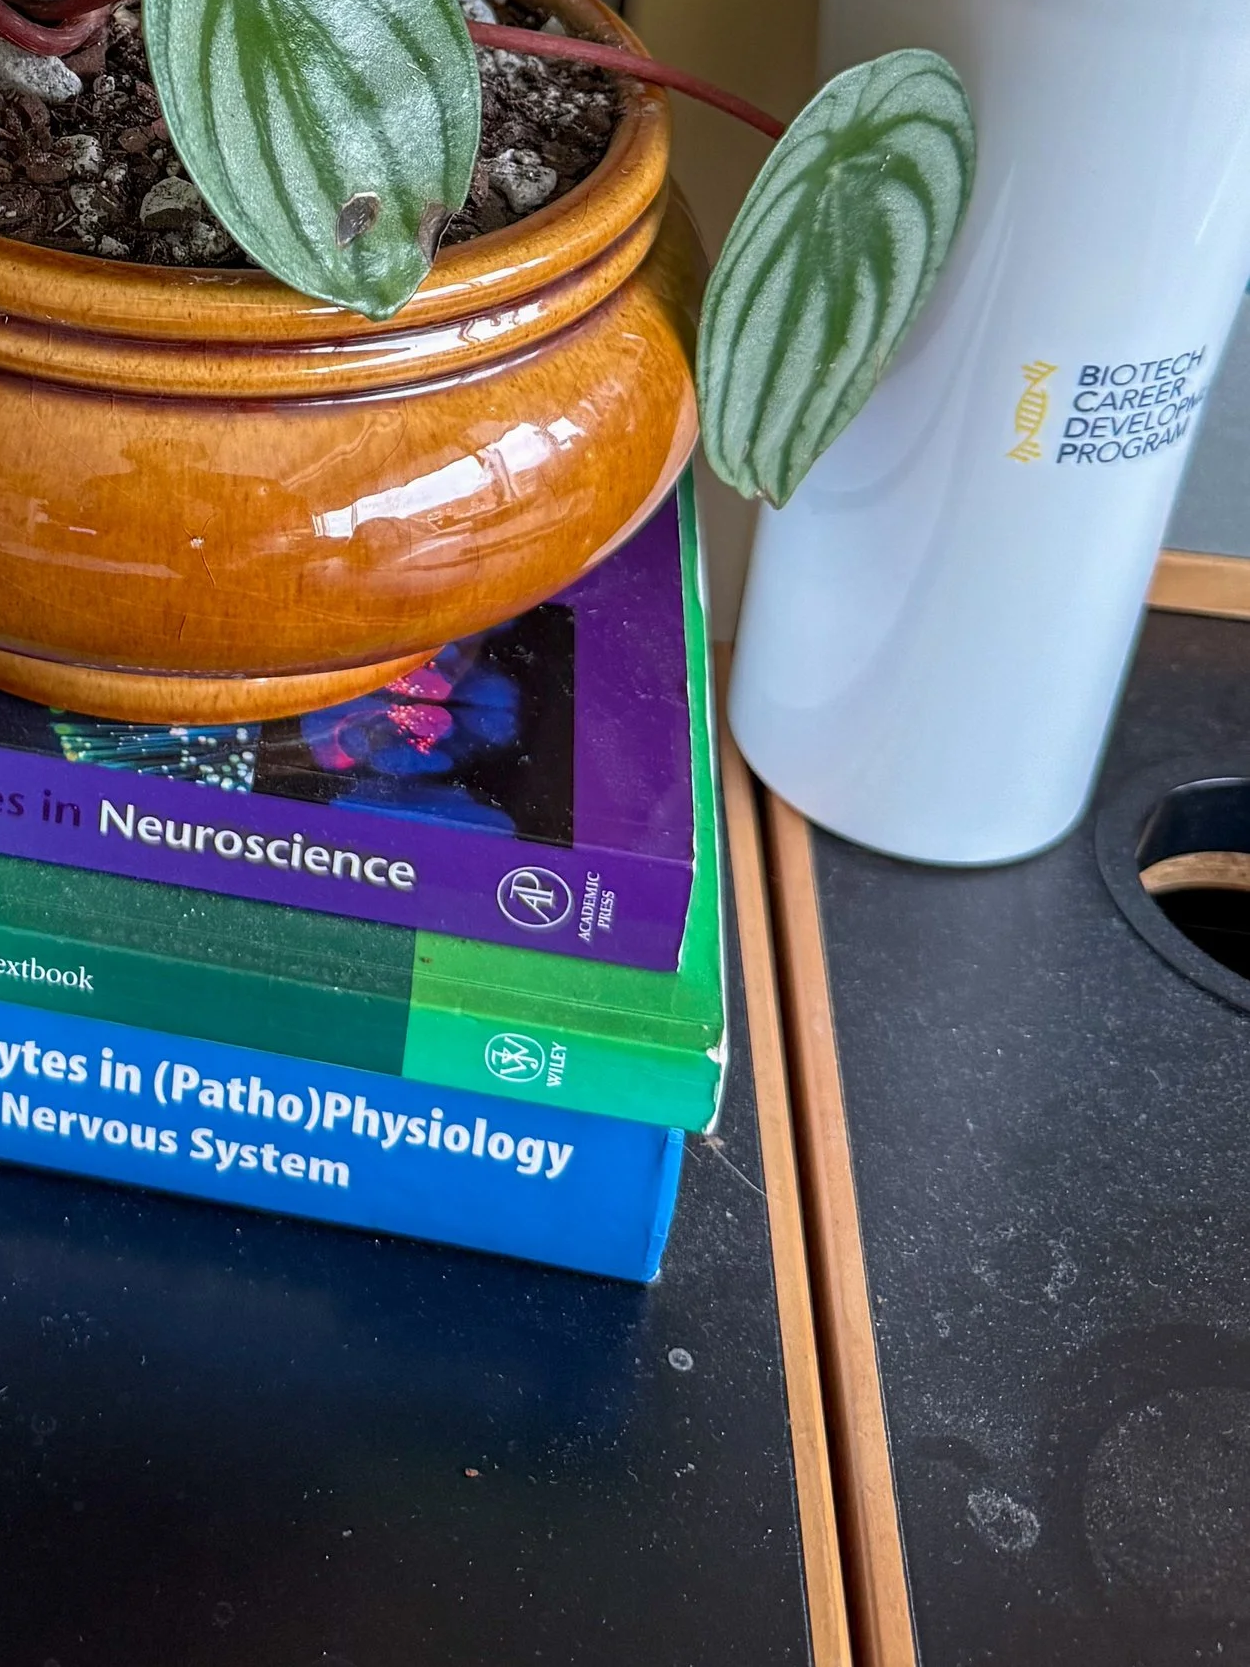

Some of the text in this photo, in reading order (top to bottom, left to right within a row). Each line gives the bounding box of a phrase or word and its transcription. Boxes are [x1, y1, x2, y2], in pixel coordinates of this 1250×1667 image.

[1078, 344, 1206, 386] BIOTECH
[1073, 377, 1186, 413] CAREER
[1056, 416, 1190, 464] PROGRAM
[42, 789, 81, 827] in
[100, 798, 417, 890] Neuroscience
[578, 871, 600, 942] ACADEMIC
[597, 889, 615, 929] PRESS
[546, 1041, 567, 1087] WILEY
[100, 1046, 142, 1095] in
[154, 1060, 574, 1179] (Patho)Physiology
[1, 1091, 178, 1155] Nervous
[190, 1127, 350, 1188] System
